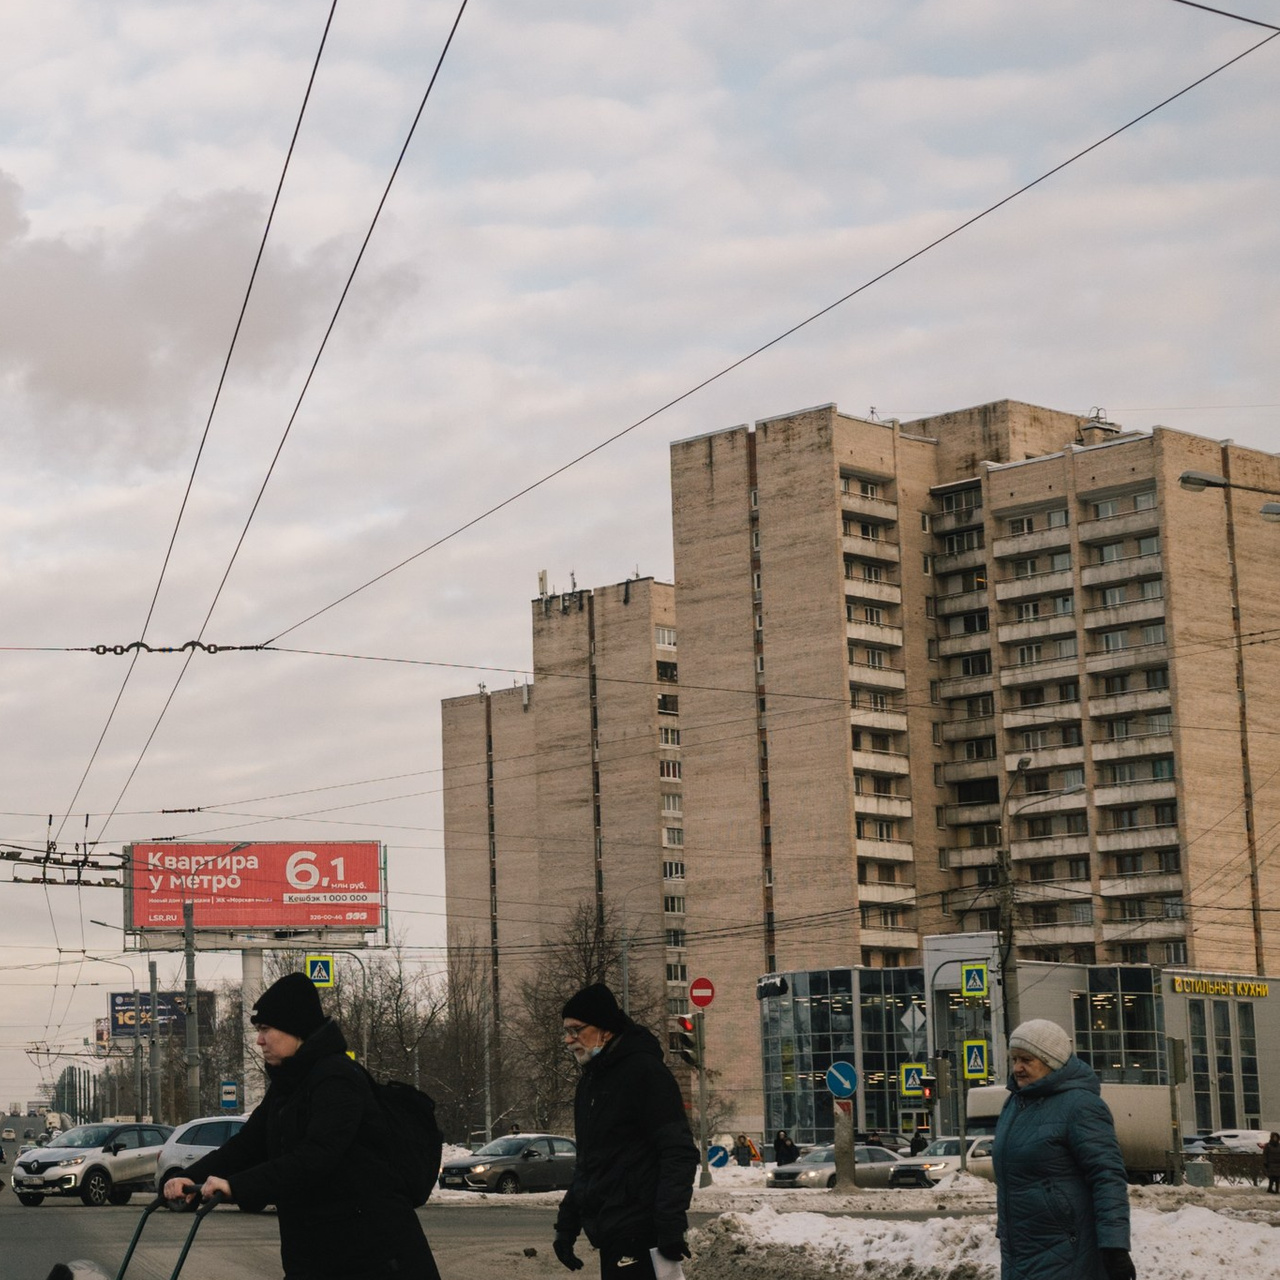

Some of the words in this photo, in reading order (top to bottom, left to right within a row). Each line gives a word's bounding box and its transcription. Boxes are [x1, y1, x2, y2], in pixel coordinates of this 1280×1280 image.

[148, 852, 259, 874] Квартира
[286, 850, 345, 890] 6,1
[149, 875, 163, 893] у
[170, 874, 241, 893] метро
[349, 882, 367, 891] руб.
[288, 894, 321, 902] Кешбэк
[1183, 977, 1234, 996] СТИЛЬНЫЕ
[1236, 981, 1269, 997] КУХНИ
